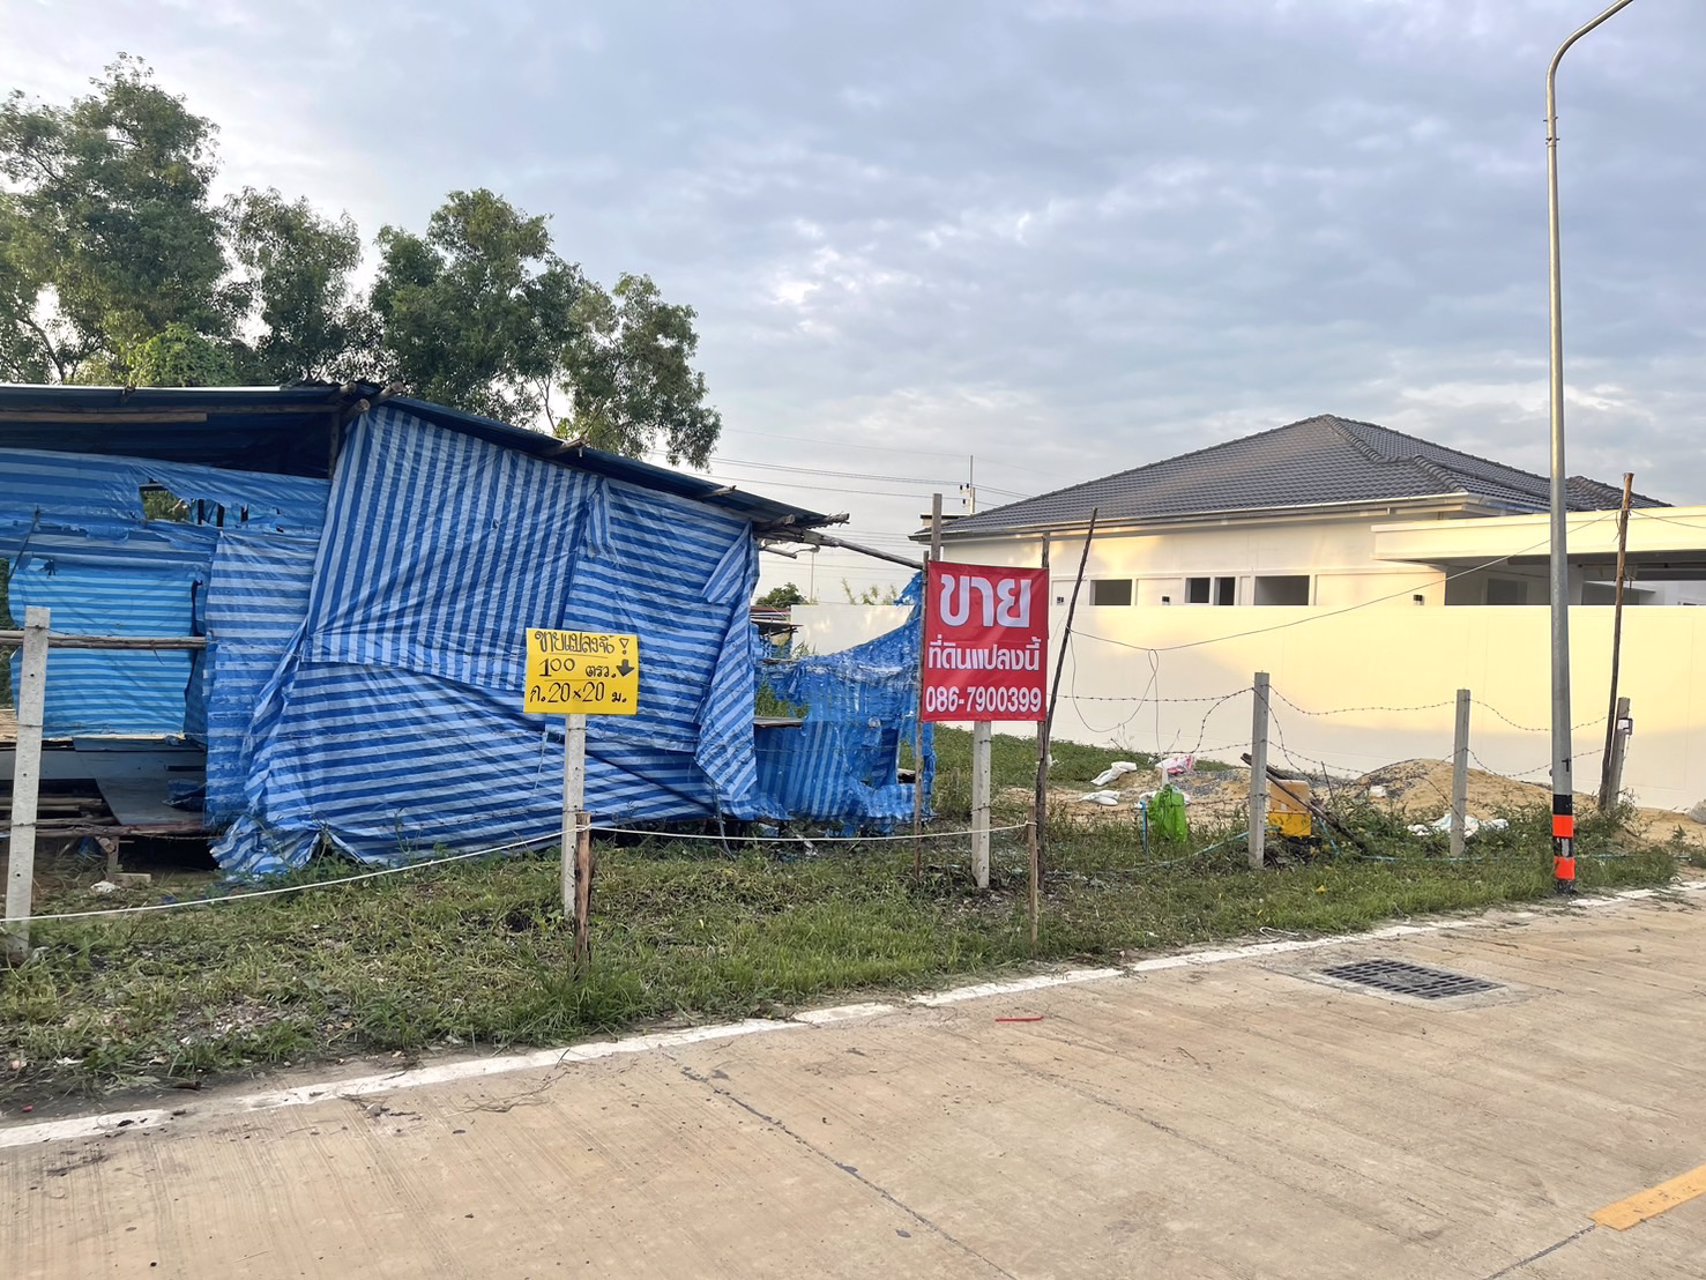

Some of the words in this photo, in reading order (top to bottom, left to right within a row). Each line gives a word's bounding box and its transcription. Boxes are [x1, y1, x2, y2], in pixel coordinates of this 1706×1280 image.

[940, 574, 1032, 628] ขาย
[539, 658, 575, 677] 100
[928, 634, 1041, 670] ที่ดินแปลงนี้
[925, 686, 1042, 713] 086-7900399
